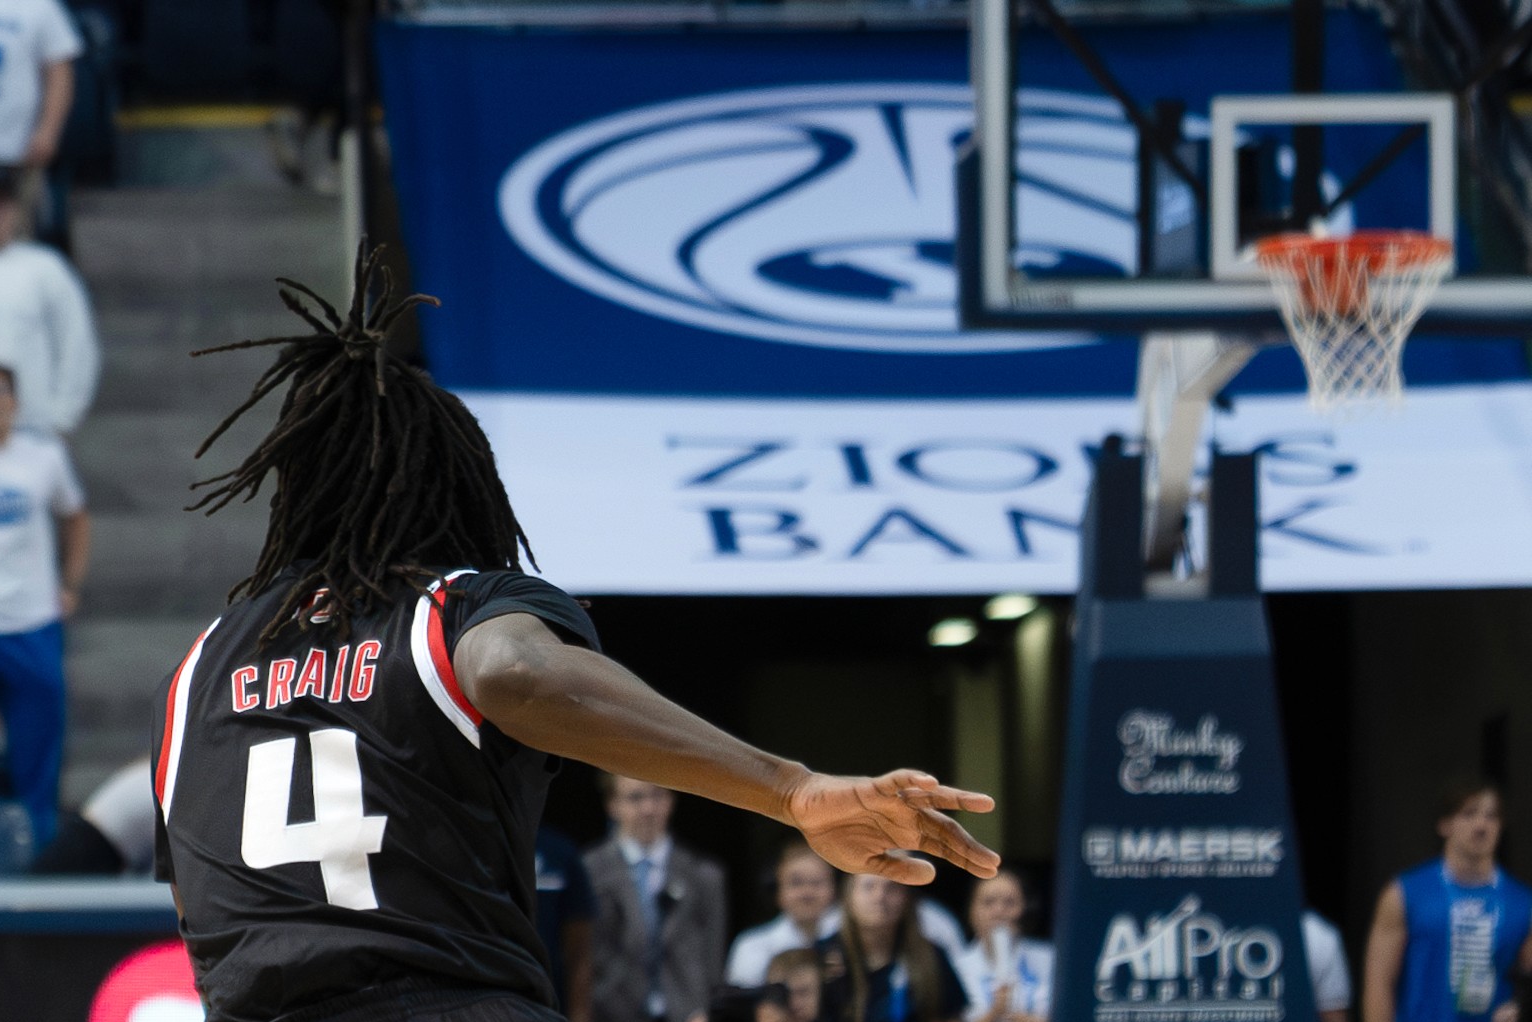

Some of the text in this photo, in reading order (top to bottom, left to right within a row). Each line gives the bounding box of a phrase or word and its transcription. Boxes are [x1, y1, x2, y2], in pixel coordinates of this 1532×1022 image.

[666, 431, 1357, 490] ZIOS
[231, 640, 382, 713] CRAIG
[241, 728, 388, 911] 4
[1120, 830, 1283, 863] MAERSK
